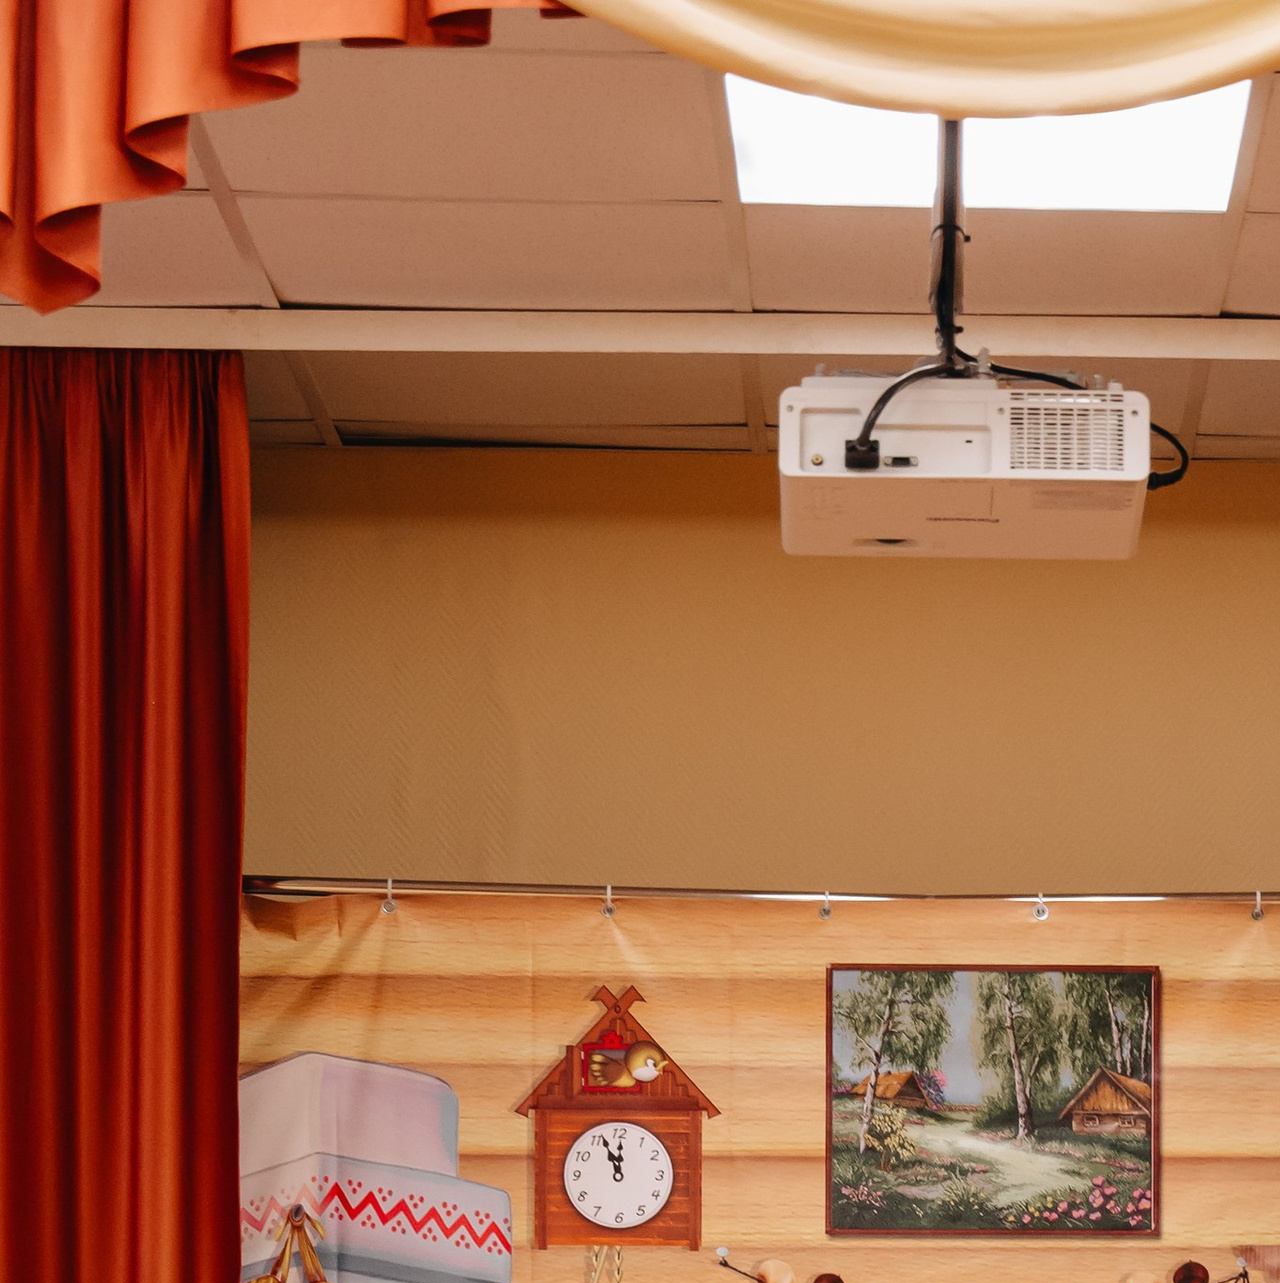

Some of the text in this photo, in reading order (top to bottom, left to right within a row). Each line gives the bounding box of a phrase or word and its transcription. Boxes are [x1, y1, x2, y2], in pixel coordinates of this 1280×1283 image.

[612, 1128, 627, 1139] 12
[575, 1151, 591, 1162] 10
[650, 1149, 660, 1161] 2
[572, 1169, 582, 1181] 9
[654, 1169, 665, 1181] 3
[577, 1190, 588, 1202] 8
[651, 1189, 661, 1201] 4
[593, 1205, 602, 1217] 7
[636, 1205, 646, 1216] 5
[614, 1212, 625, 1223] 6
